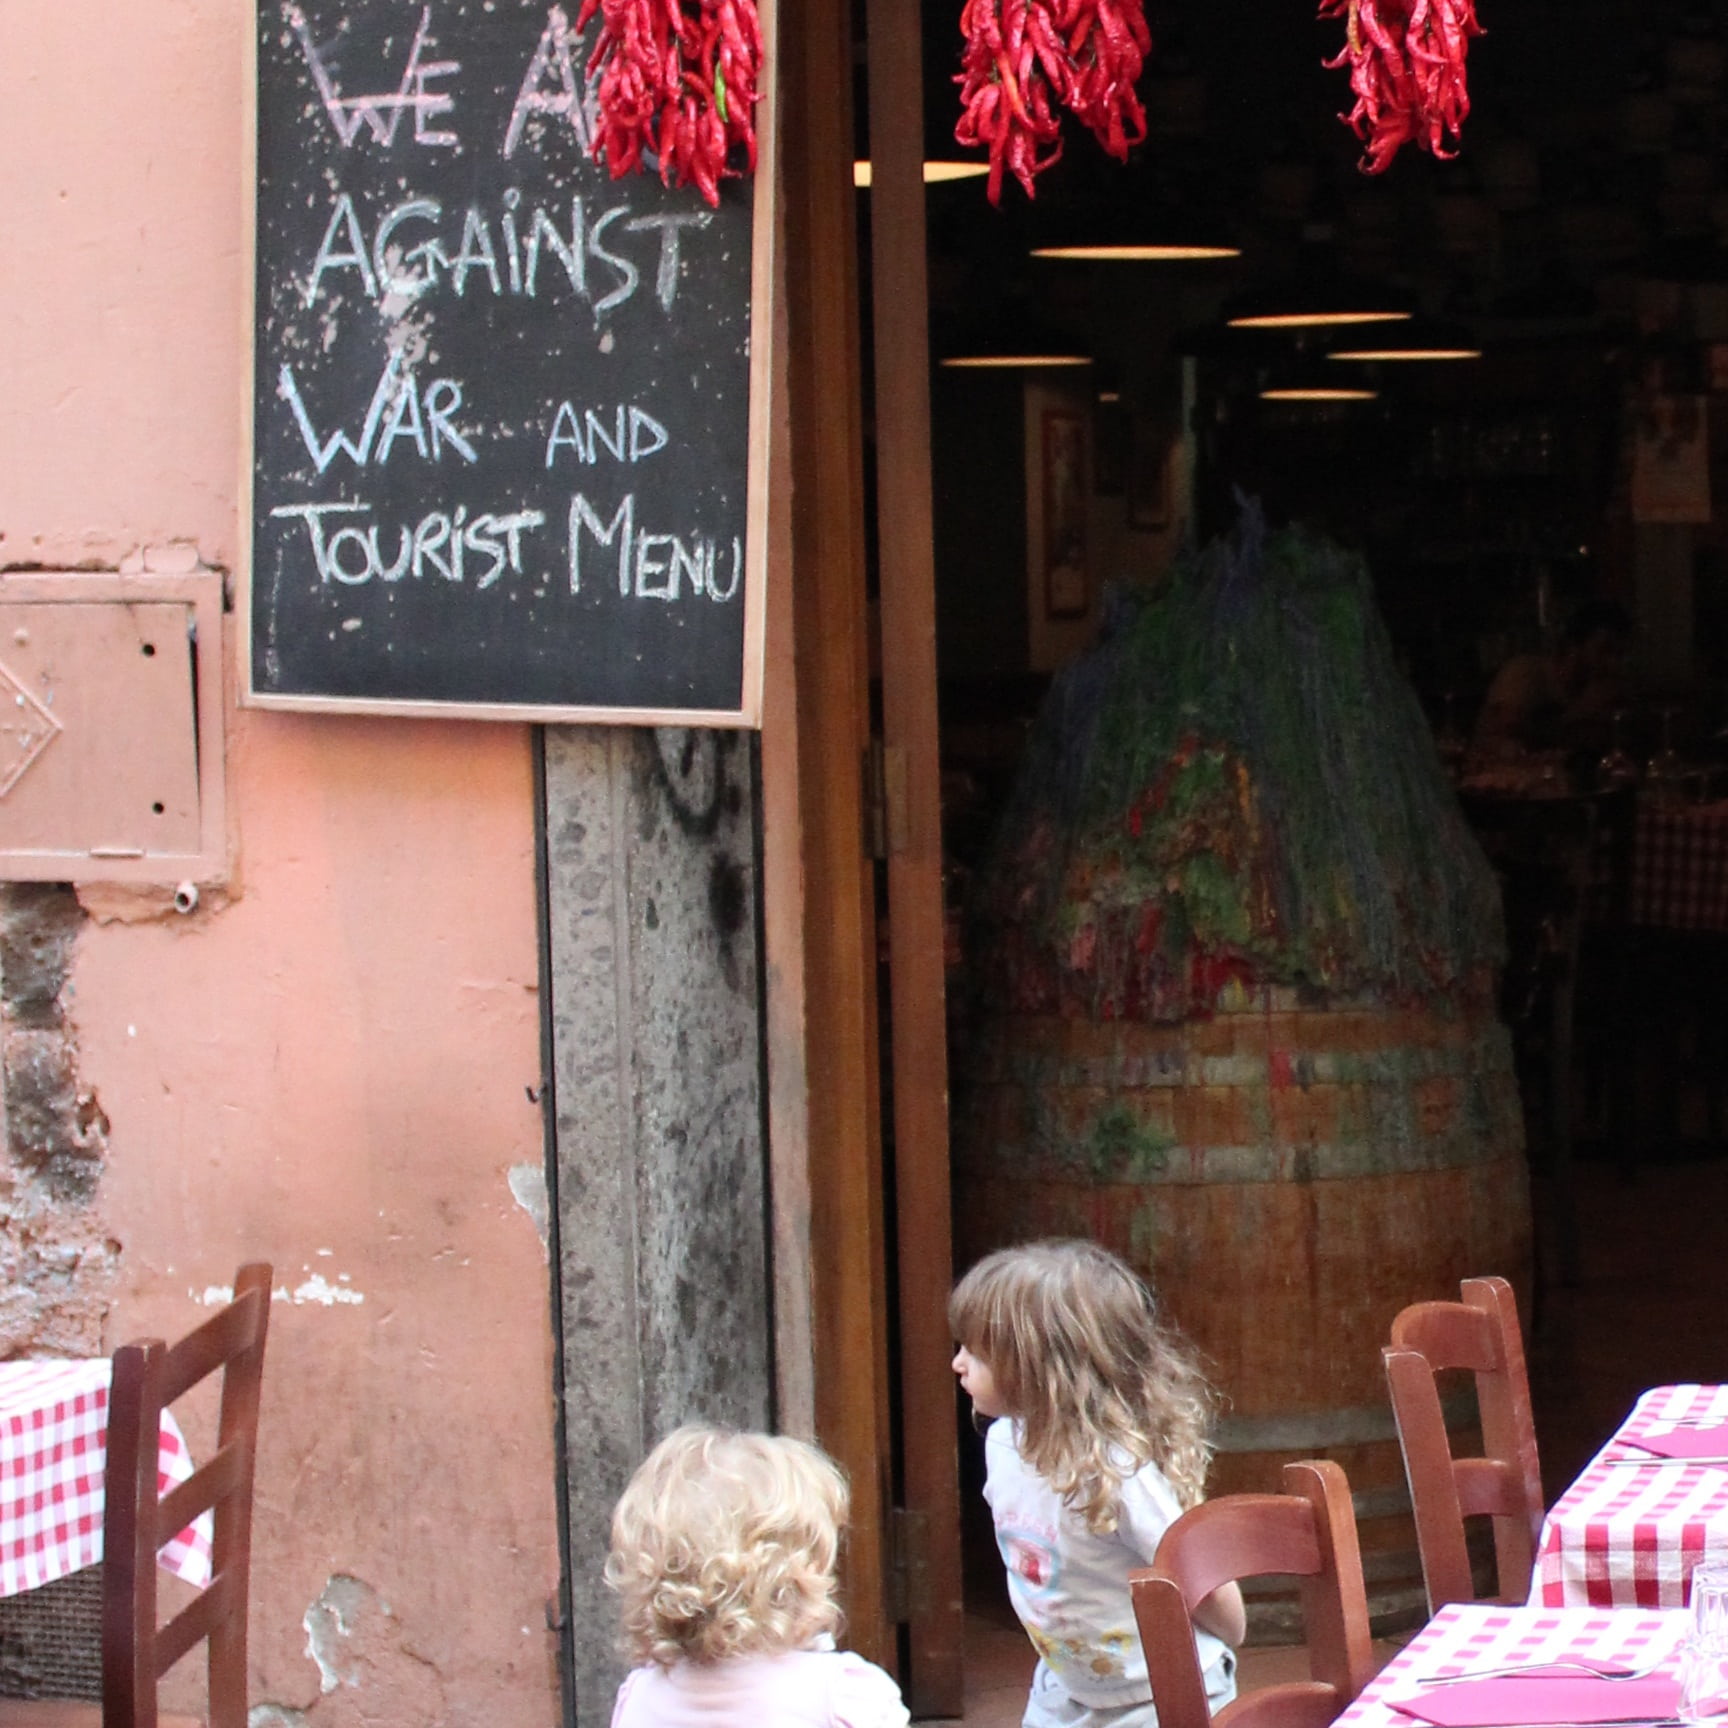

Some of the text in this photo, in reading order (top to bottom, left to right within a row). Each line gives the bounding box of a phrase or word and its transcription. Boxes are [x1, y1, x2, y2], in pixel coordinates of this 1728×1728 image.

[280, 5, 462, 148] WE
[305, 187, 712, 313] AGAINST
[279, 350, 669, 472] WAR AND
[270, 503, 545, 589] TOURIST
